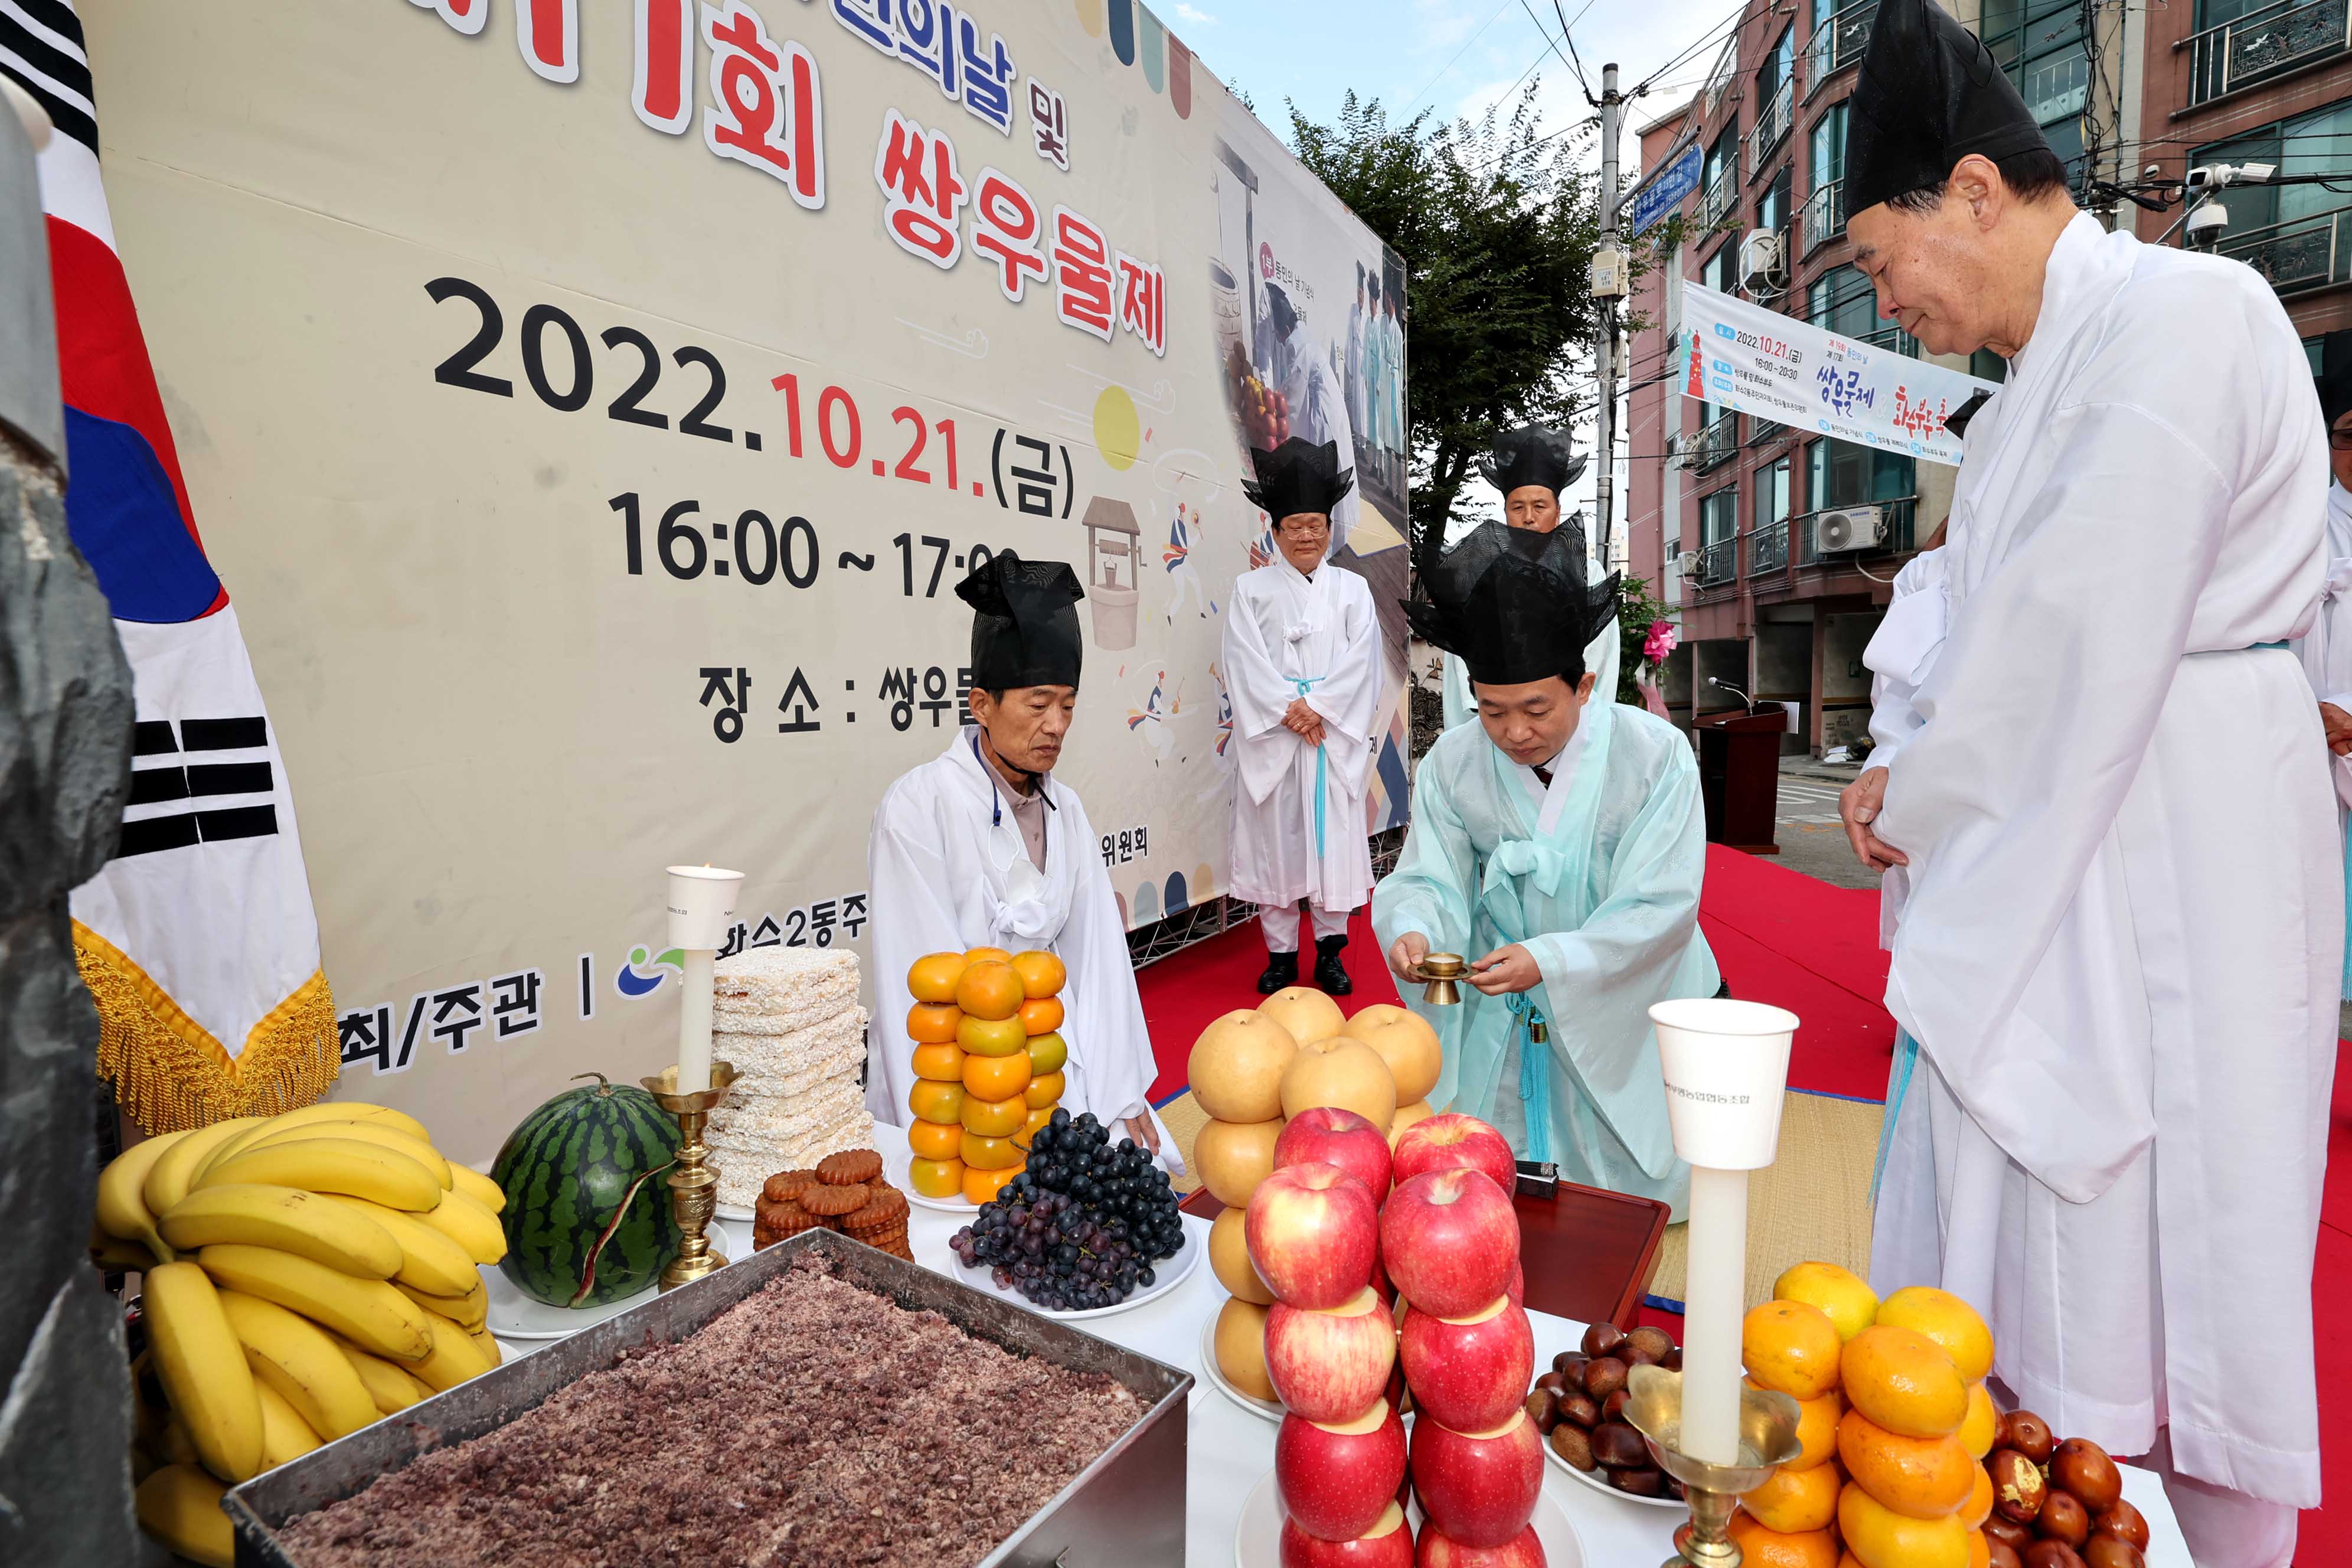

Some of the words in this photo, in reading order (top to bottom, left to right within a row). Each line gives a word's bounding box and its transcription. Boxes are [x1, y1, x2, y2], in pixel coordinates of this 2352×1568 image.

[1031, 83, 1064, 165] 및
[883, 119, 1162, 349] 쌍우물제
[1261, 253, 1273, 276] 1부
[1275, 260, 1293, 287] 동민의
[1295, 274, 1301, 292] 날
[1737, 331, 1802, 363] 2022.10.21.(금)
[1754, 375, 1772, 387] 화수부두
[1755, 358, 1773, 371] 16:00
[1779, 366, 1798, 380] 20:30
[424, 276, 1073, 518] 2022.10.21.(금)
[1817, 365, 1874, 418] 쌍우물제
[1893, 386, 1933, 441] 화수부두
[1936, 398, 1951, 437] 축
[607, 492, 819, 588] 16:00
[698, 667, 751, 743] 장
[779, 665, 821, 733] 소
[1102, 827, 1147, 867] 위원회
